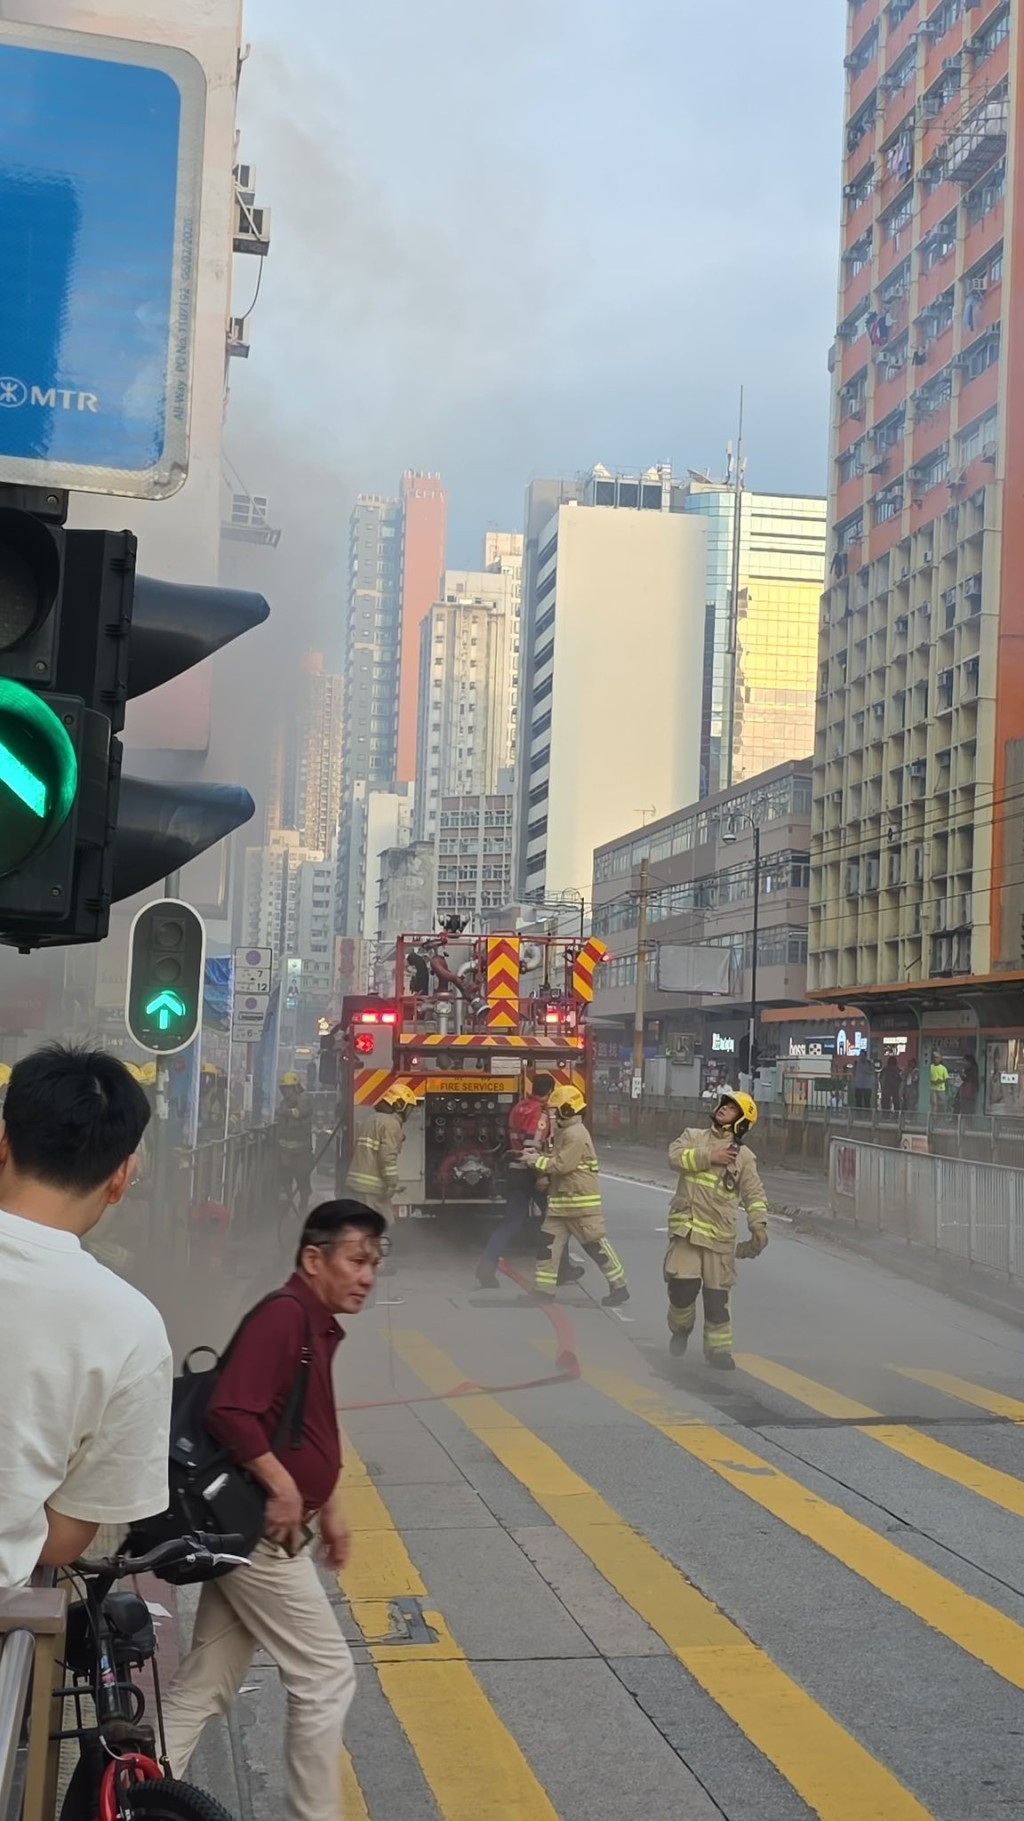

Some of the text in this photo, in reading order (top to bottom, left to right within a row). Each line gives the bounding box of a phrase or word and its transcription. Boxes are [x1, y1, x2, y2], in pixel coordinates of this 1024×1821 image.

[31, 385, 98, 413] MTR
[257, 983, 268, 991] 12
[440, 1082, 505, 1091] FIRE SERVICES
